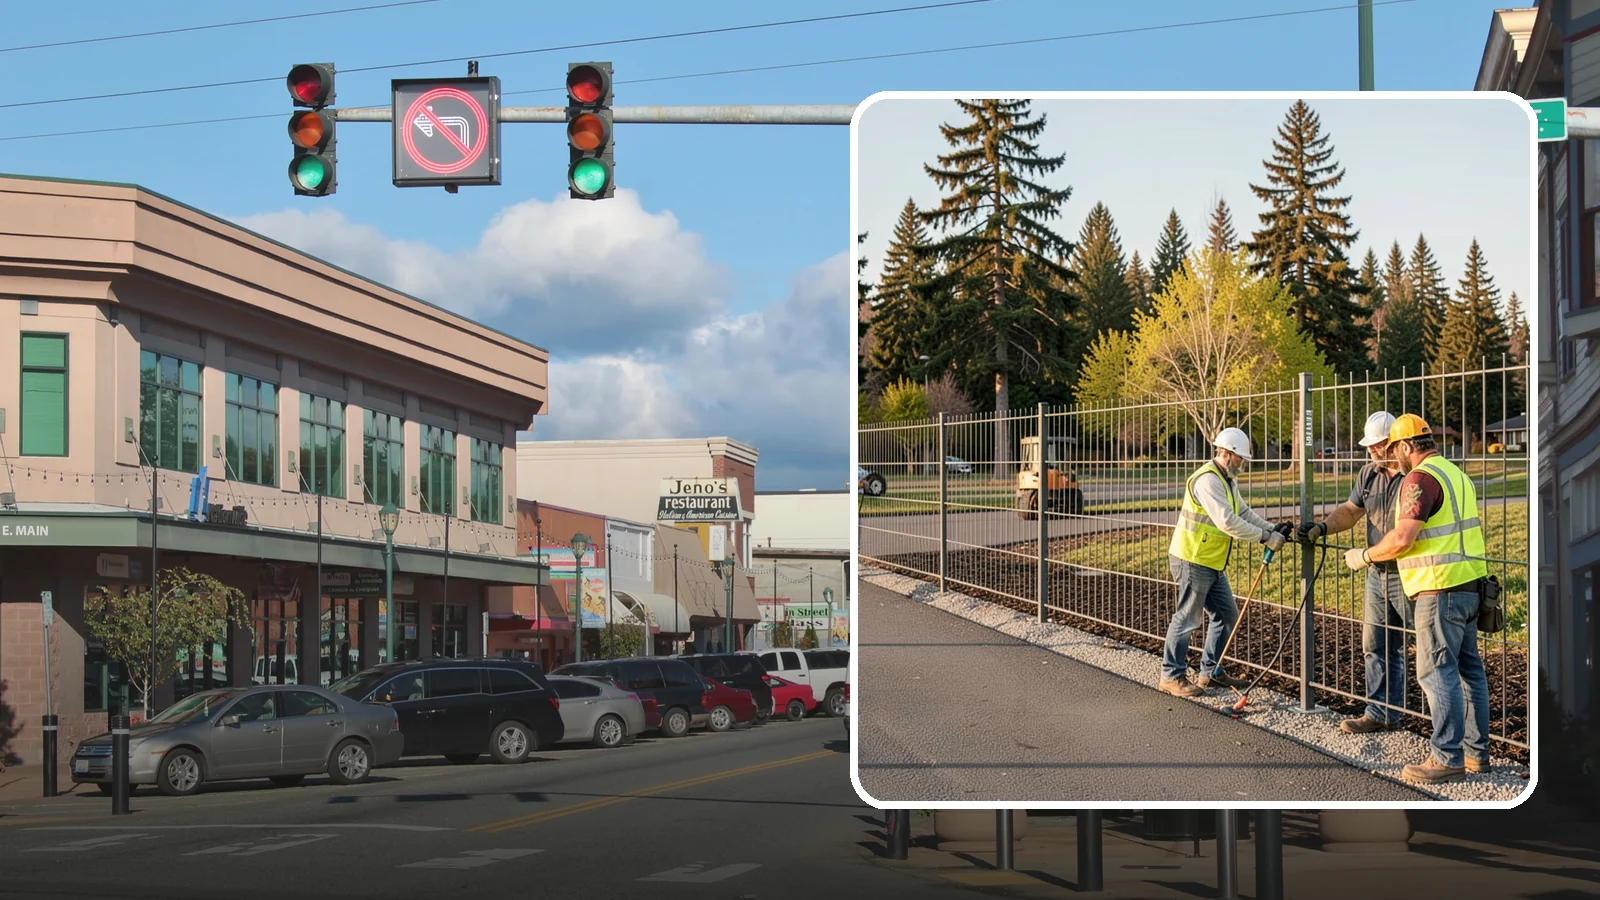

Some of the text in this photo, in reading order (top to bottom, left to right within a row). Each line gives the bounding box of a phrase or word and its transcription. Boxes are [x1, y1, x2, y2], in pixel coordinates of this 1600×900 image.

[670, 480, 727, 494] Jeno's
[665, 496, 731, 509] restaurant
[686, 509, 715, 519] American
[715, 509, 738, 519] Cuisine
[2, 525, 49, 536] E. MAIN
[797, 607, 828, 617] Street
